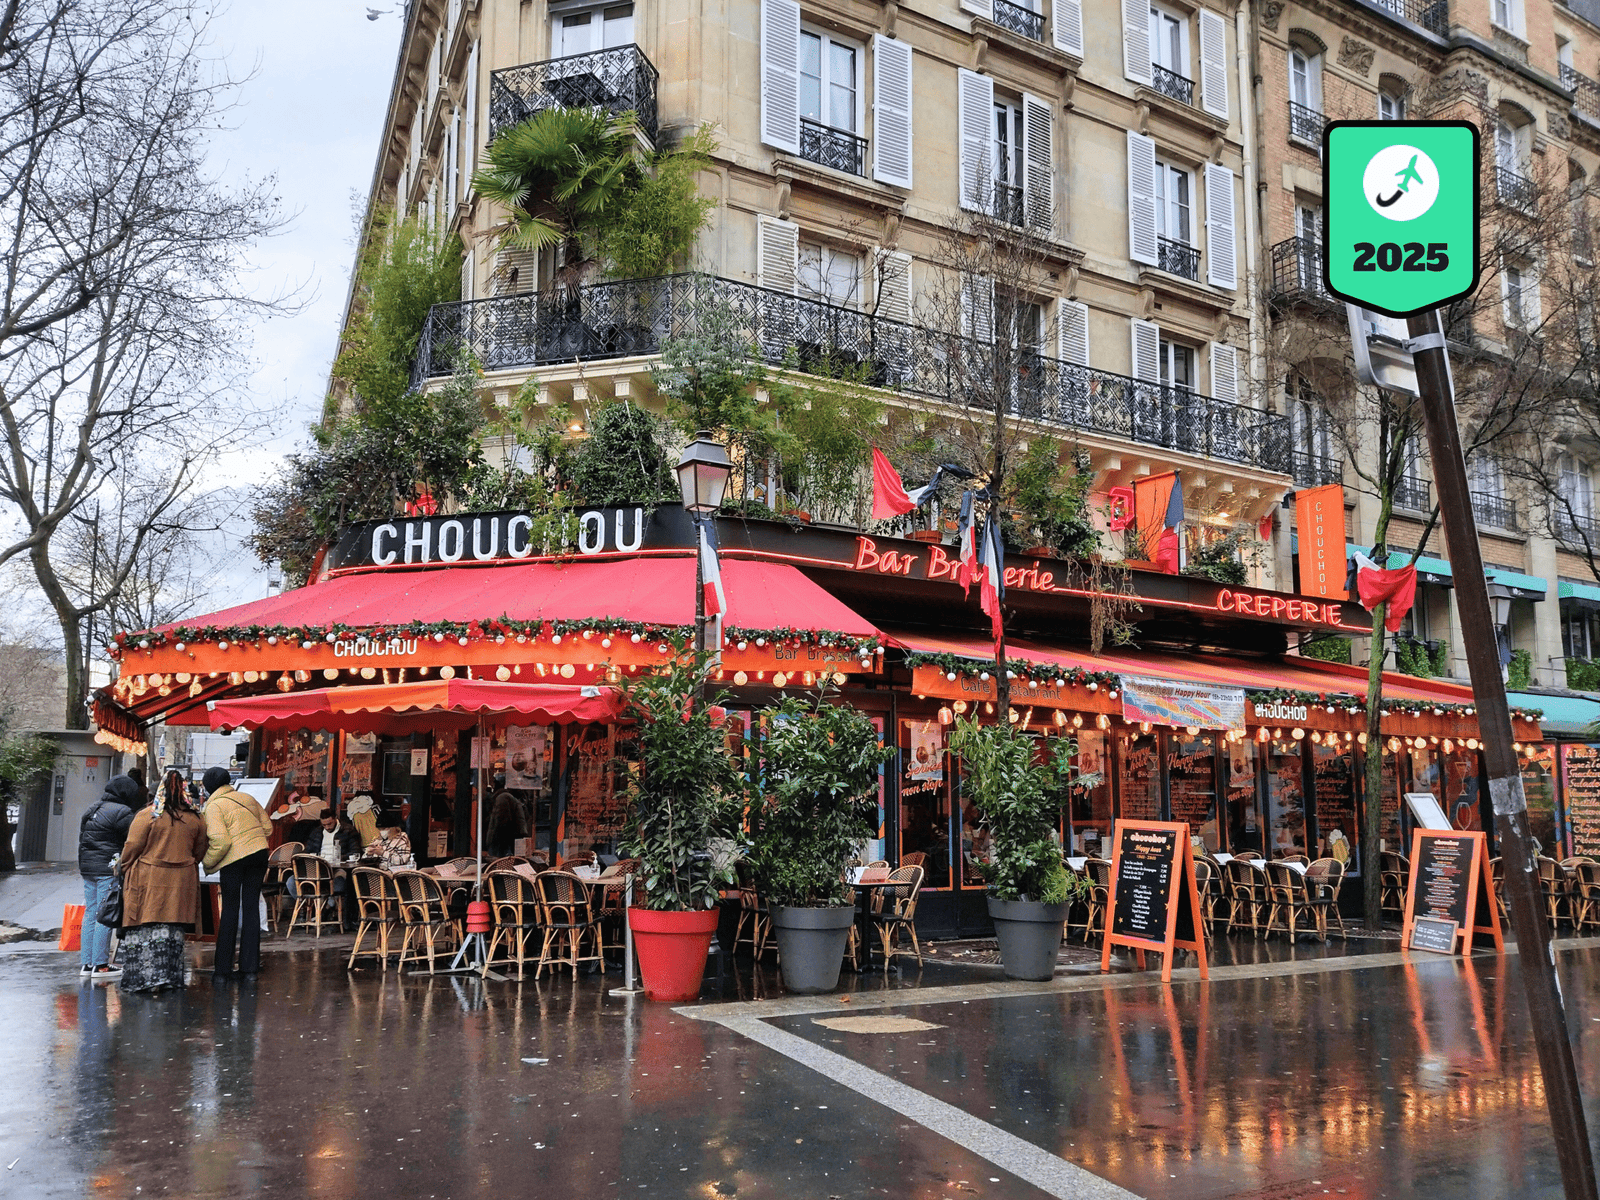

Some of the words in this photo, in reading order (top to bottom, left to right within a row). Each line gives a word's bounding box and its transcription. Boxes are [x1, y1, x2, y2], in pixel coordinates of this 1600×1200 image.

[371, 507, 643, 566] CHOUCOU
[1315, 501, 1327, 595] CHOUCHOU
[856, 536, 918, 576] Bar
[927, 545, 1056, 592] Brerie
[1216, 588, 1342, 627] CREPERIE
[1007, 682, 1062, 700] estaurant
[1175, 688, 1196, 699] Happy
[1196, 690, 1212, 699] Hour
[905, 760, 942, 778] Service
